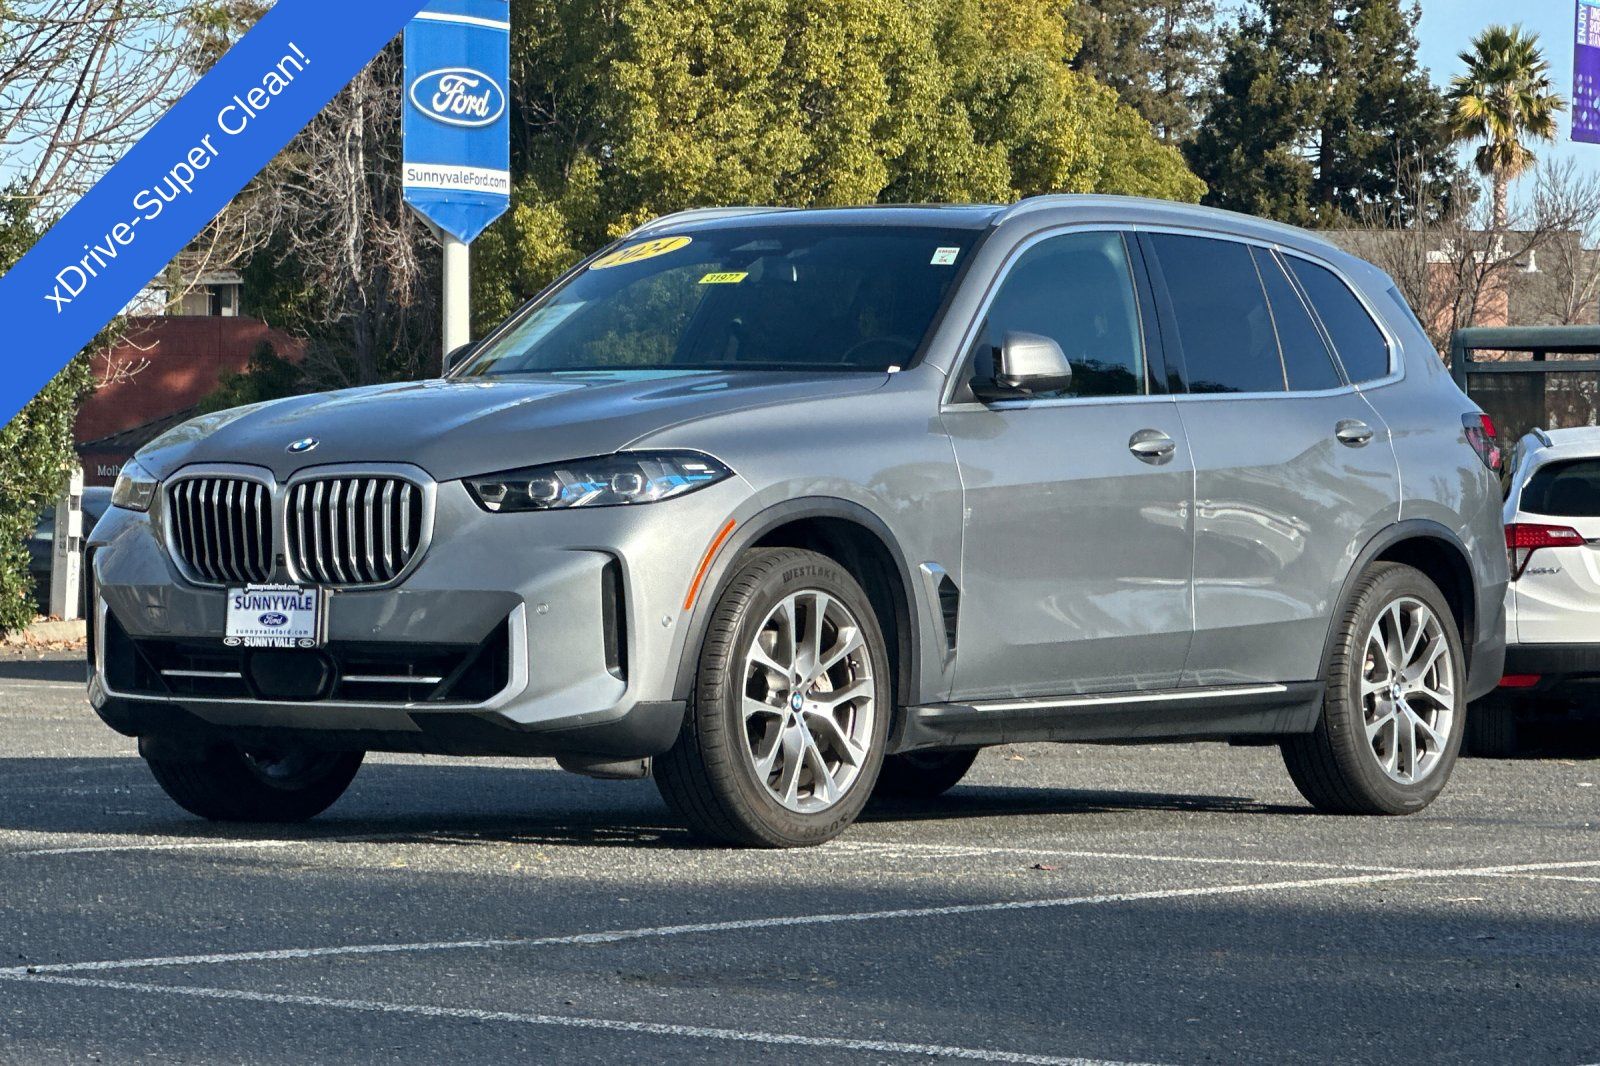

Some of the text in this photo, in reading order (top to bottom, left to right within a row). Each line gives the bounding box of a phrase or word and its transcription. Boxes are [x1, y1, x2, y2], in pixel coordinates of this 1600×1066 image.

[1578, 3, 1587, 45] ENJOY
[432, 74, 491, 117] Ford
[407, 168, 507, 188] SunnyvaleFord.com
[706, 273, 740, 282] 31977
[782, 565, 837, 584] WESTLAKE
[234, 595, 312, 611] SUNNYVALE
[263, 614, 283, 625] Ford
[244, 637, 296, 647] SUNNYVALE
